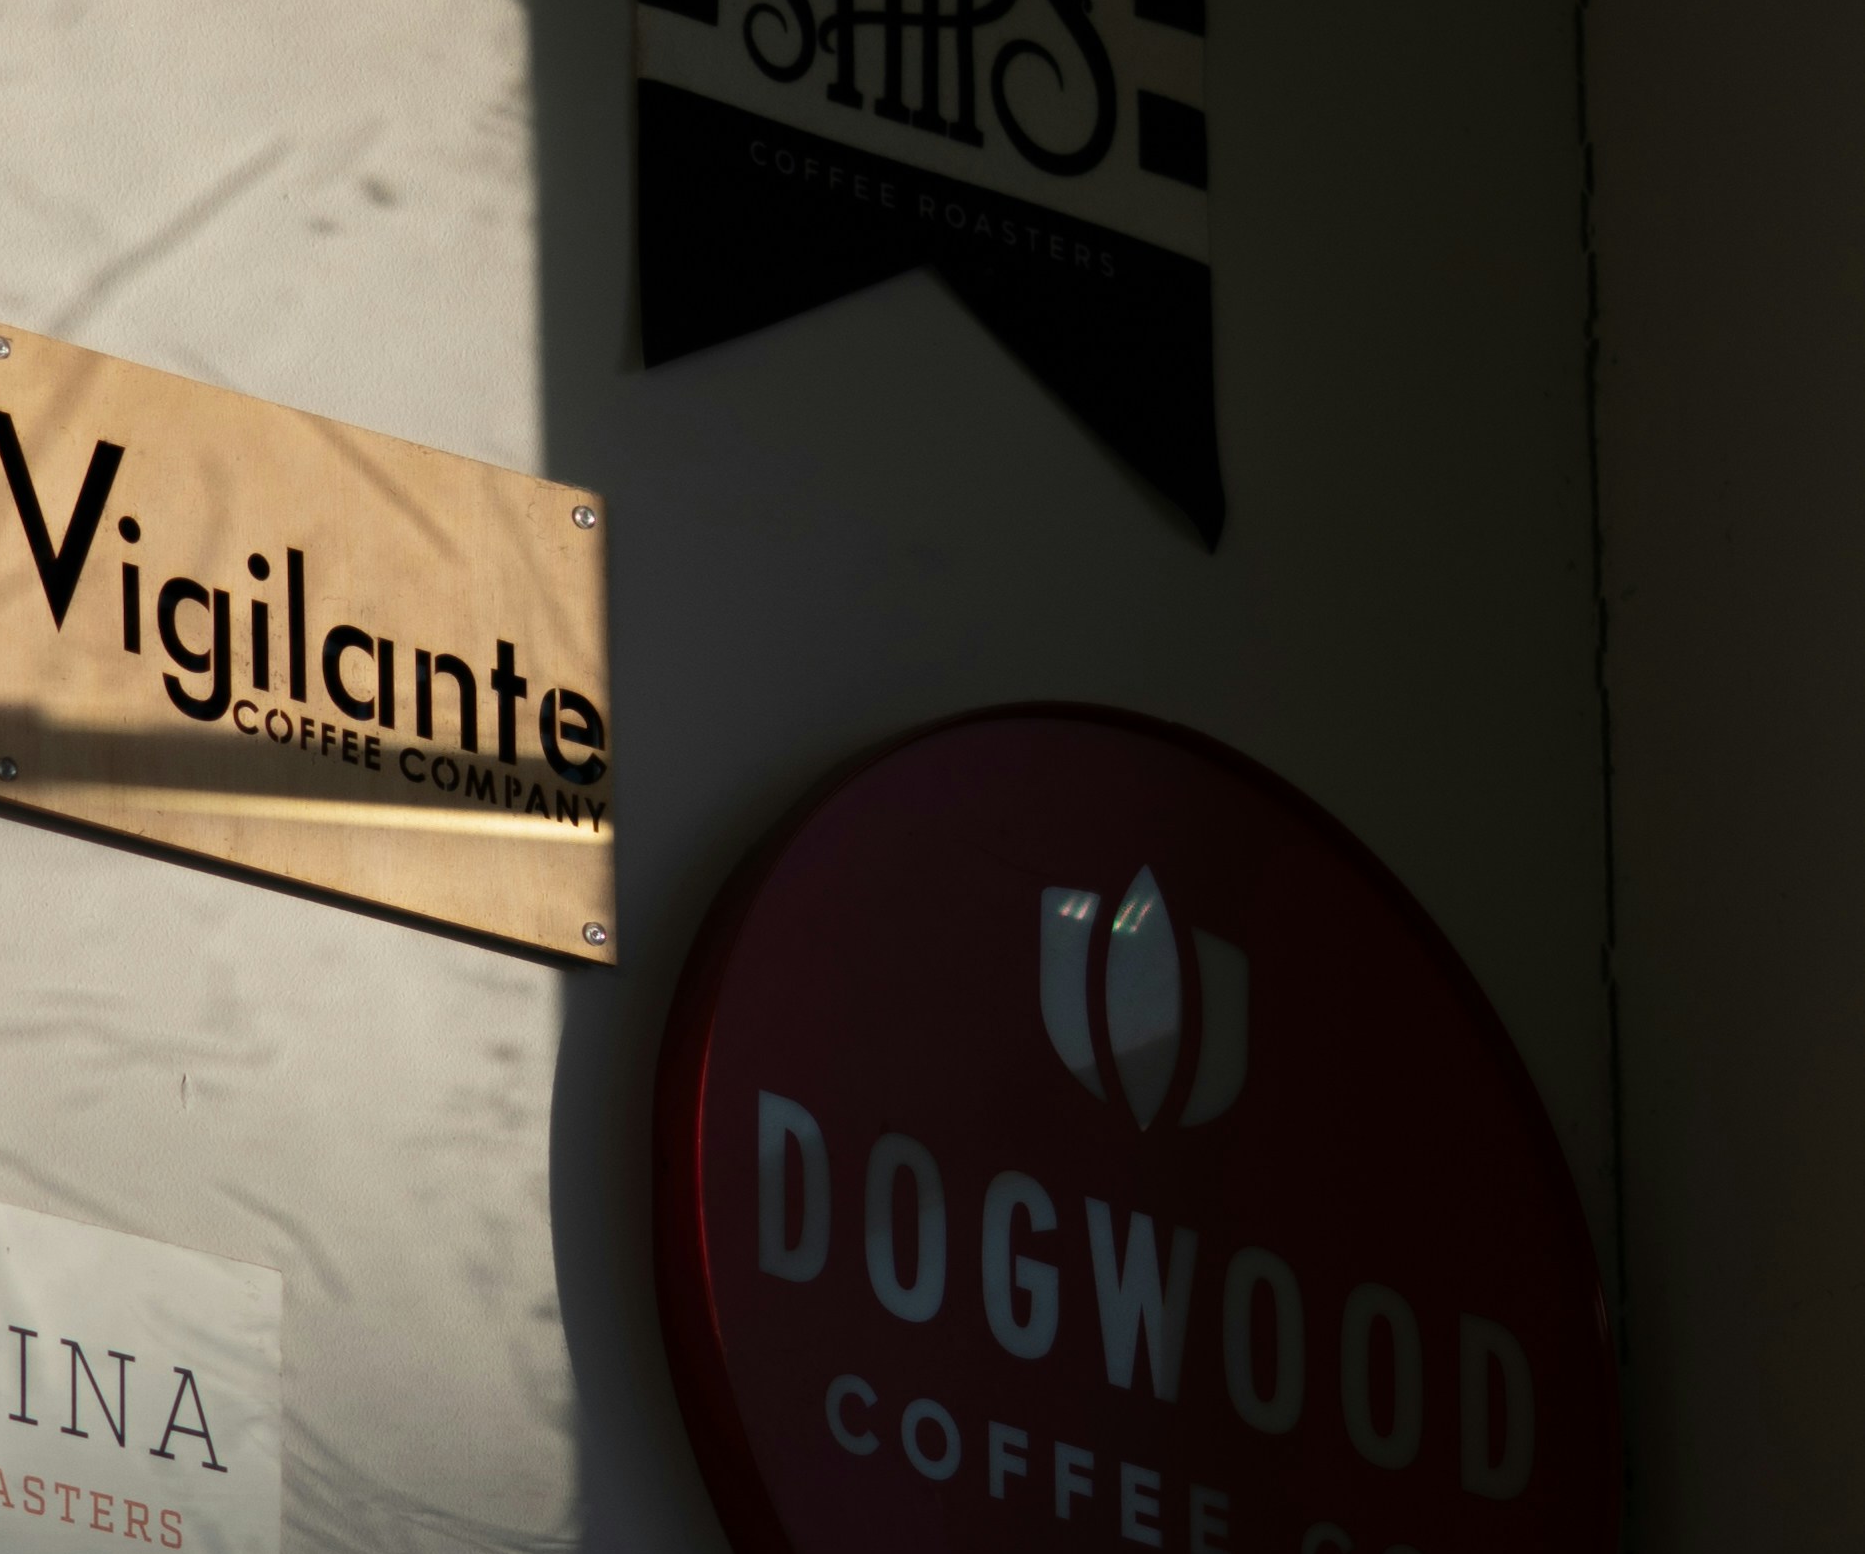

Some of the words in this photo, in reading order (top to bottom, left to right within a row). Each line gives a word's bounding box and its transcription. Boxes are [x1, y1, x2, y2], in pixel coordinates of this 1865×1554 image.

[749, 140, 895, 209] COFFEE
[919, 194, 1116, 278] ROASTERS
[234, 699, 380, 772] COFFEE
[399, 747, 607, 833] COMPANY
[757, 1088, 1536, 1502] DOGWOOD
